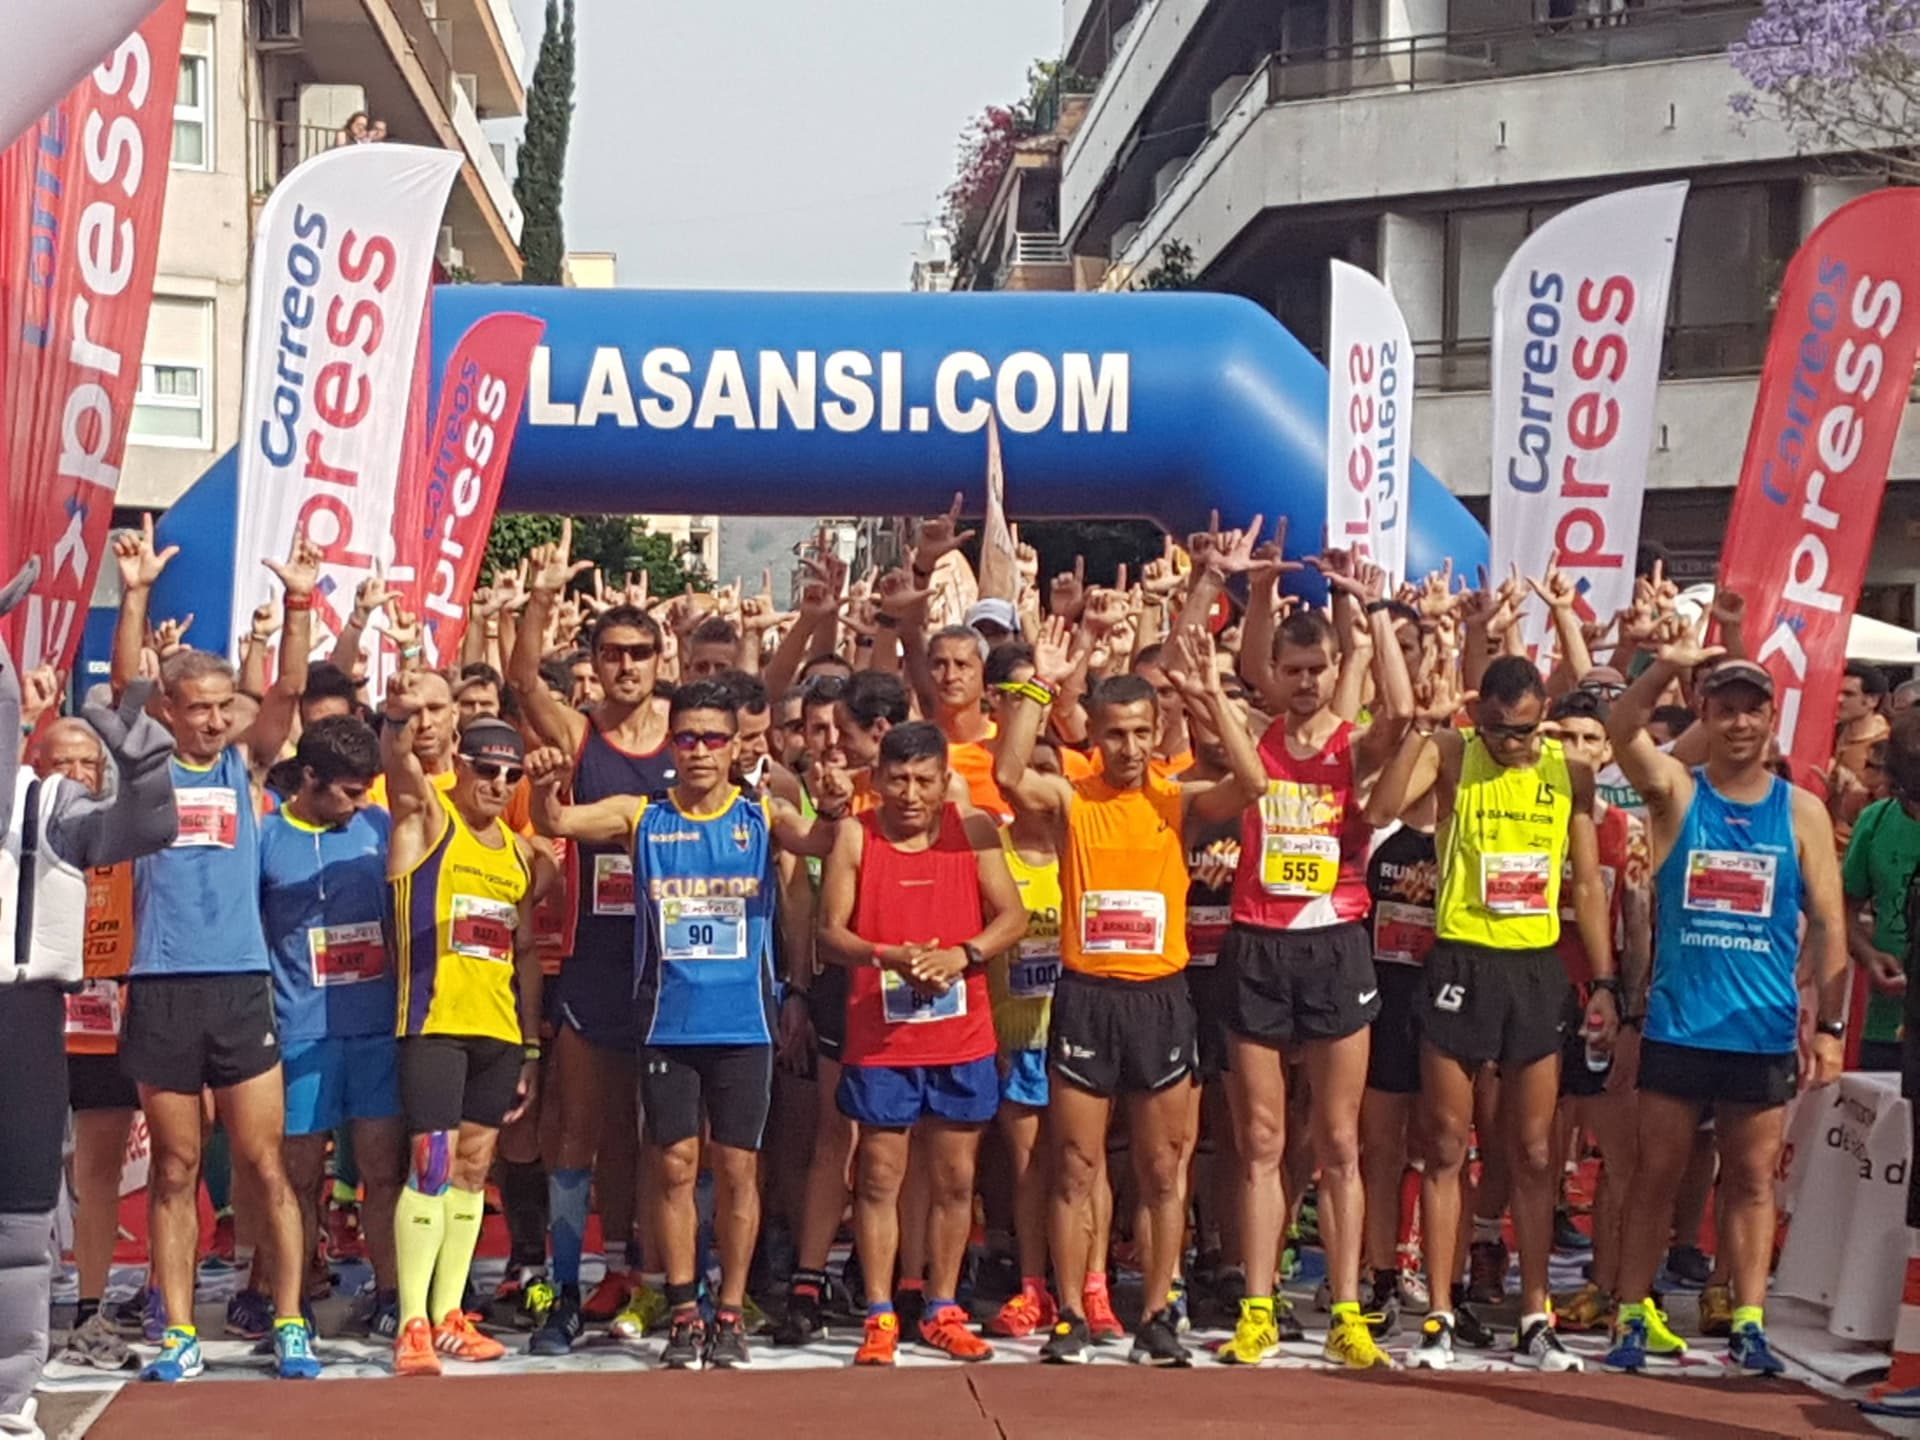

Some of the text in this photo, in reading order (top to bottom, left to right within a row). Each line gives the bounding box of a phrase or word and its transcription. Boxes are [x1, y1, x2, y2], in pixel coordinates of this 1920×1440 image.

[260, 203, 328, 469] Correos
[528, 345, 1130, 433] LASANSI.COM
[1509, 269, 1564, 494] Correos
[1761, 255, 1849, 506] Correos
[650, 877, 760, 900] ECUADOR
[1282, 861, 1320, 883] 555
[688, 924, 714, 946] 90
